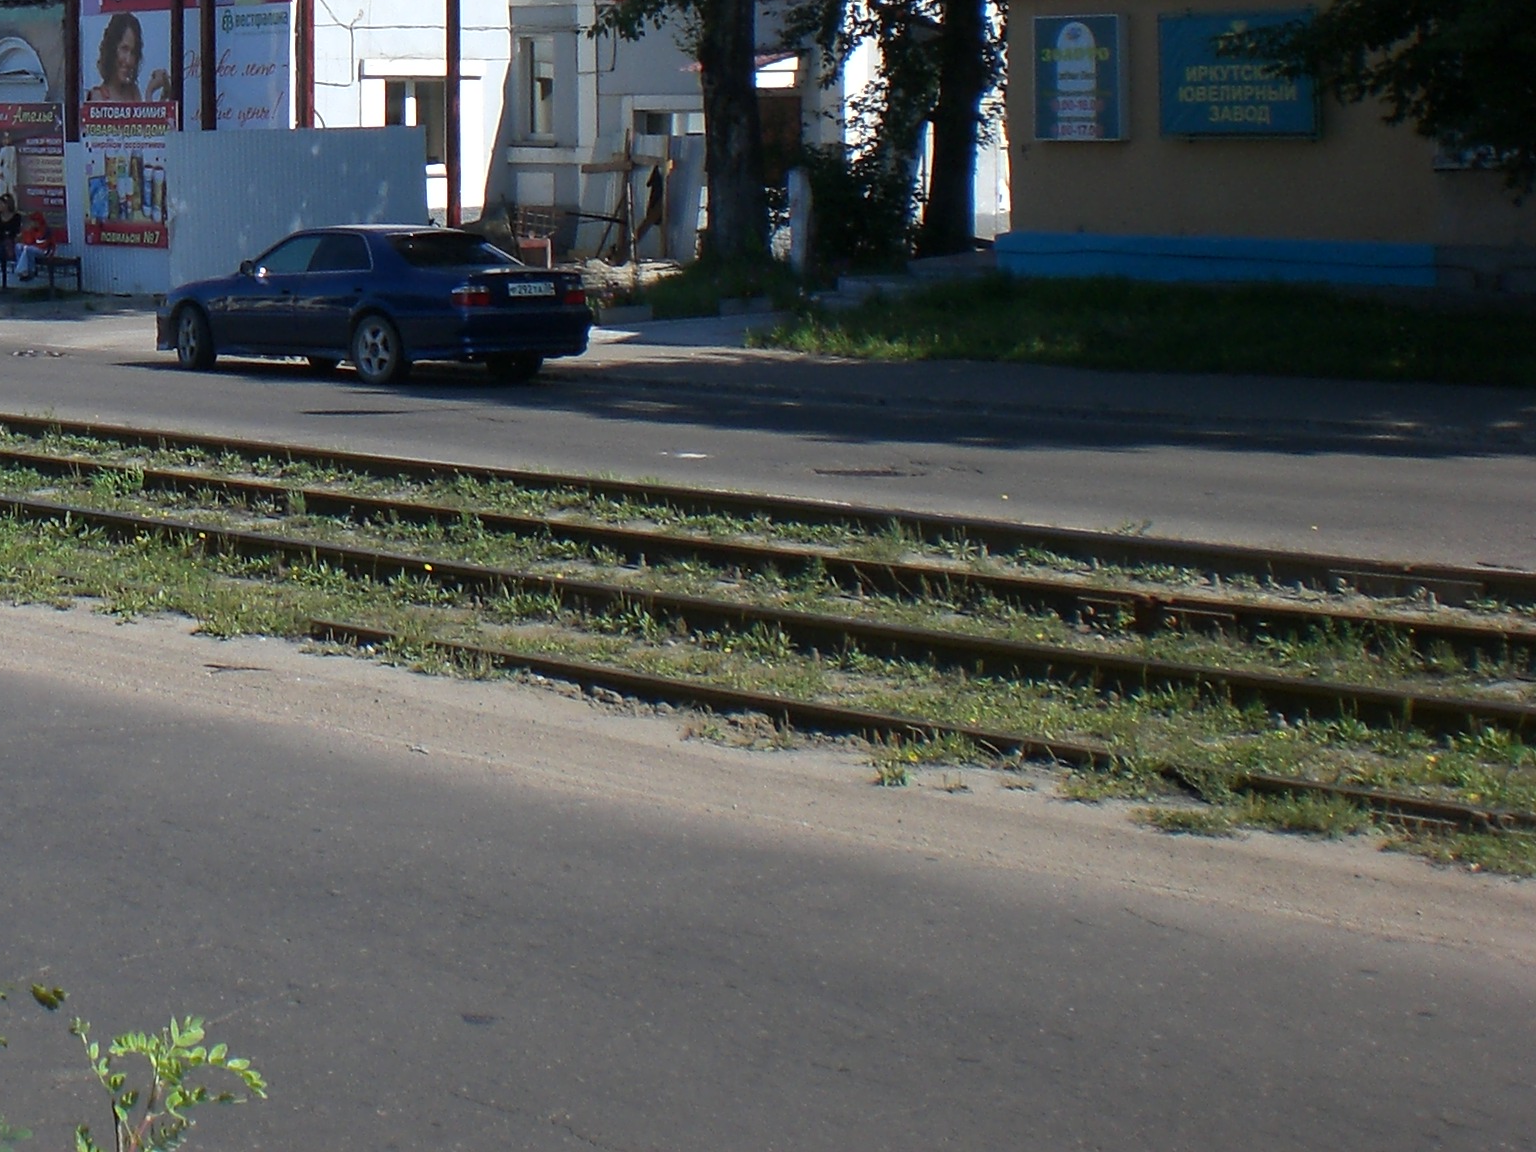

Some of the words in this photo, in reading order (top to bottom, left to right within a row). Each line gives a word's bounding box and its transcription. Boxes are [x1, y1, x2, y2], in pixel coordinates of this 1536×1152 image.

[1185, 64, 1291, 82] ИРКУТСК
[1178, 84, 1297, 102] ЮВЕЛИРНЫЙ
[90, 106, 131, 119] БЫТОВАЯ
[133, 106, 167, 119] ХИМИЯ
[1208, 105, 1271, 125] ЗАВОД
[85, 124, 121, 137] ТОВАРЫ
[101, 232, 141, 244] павильон
[143, 230, 161, 245] №7
